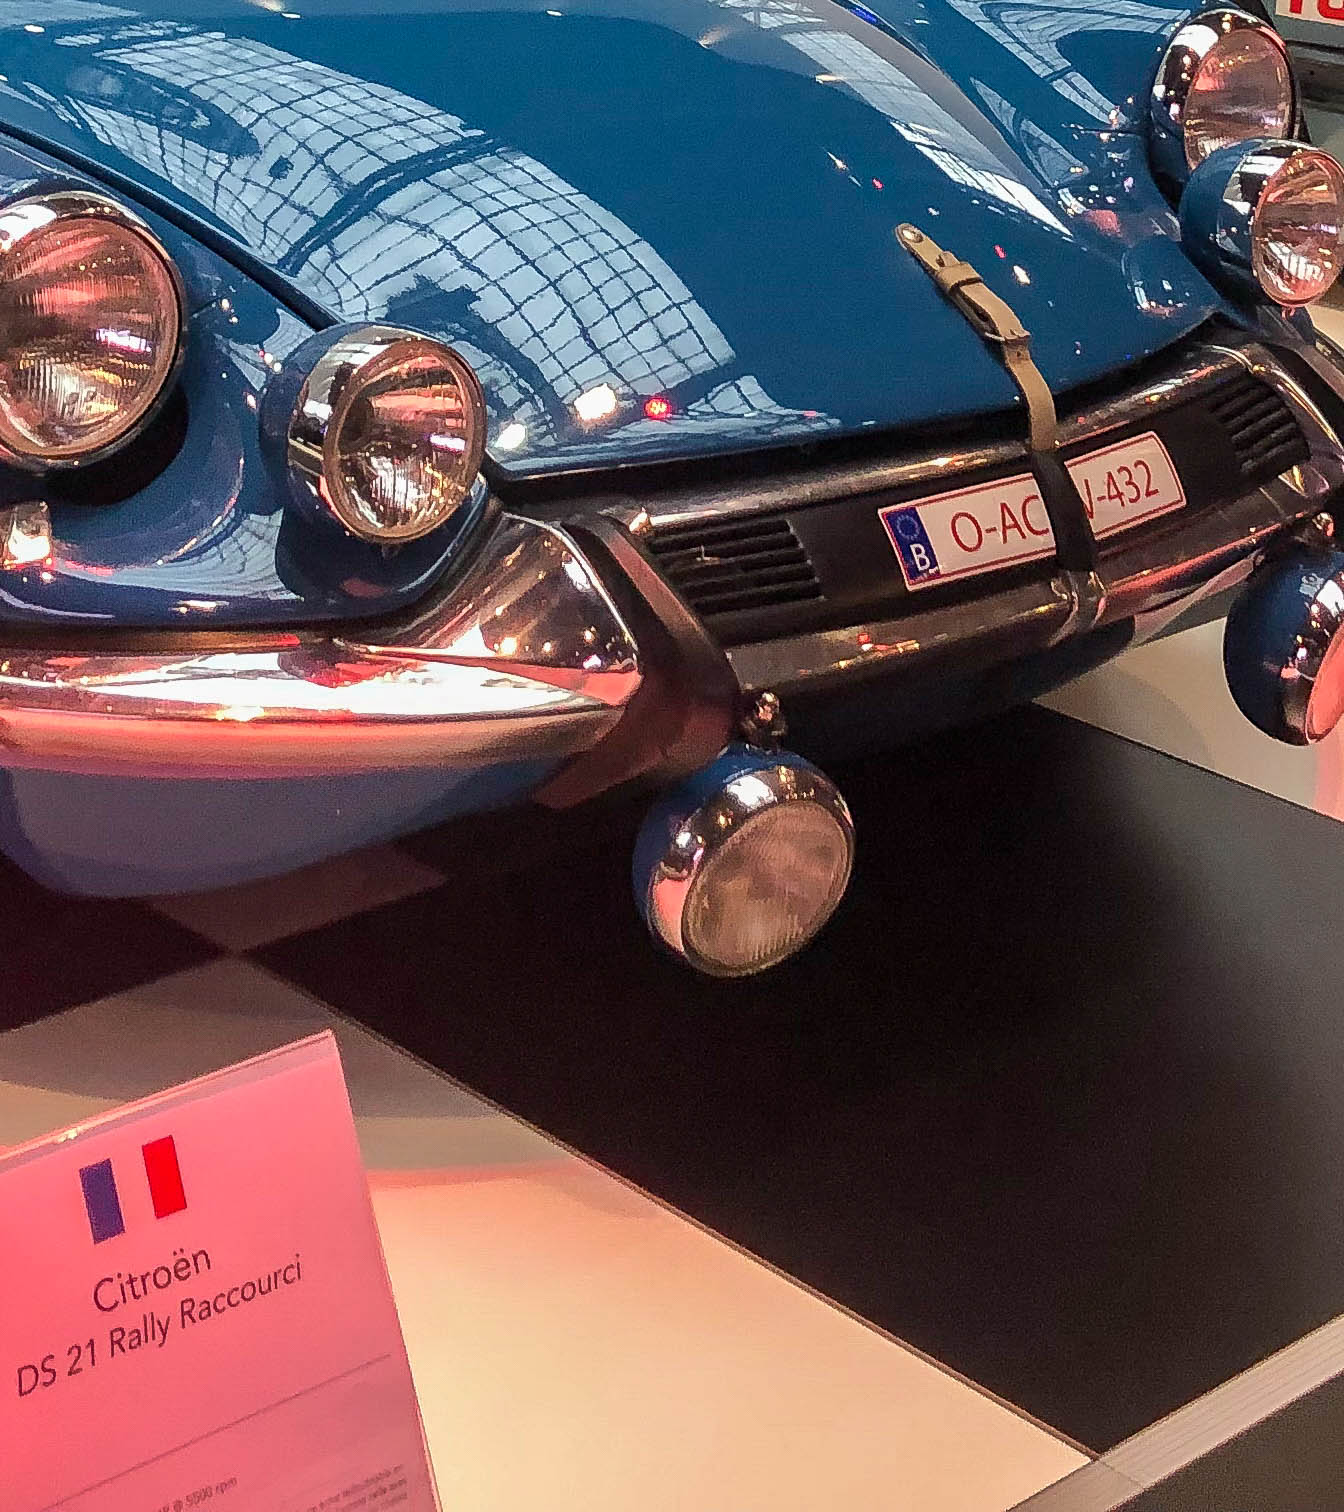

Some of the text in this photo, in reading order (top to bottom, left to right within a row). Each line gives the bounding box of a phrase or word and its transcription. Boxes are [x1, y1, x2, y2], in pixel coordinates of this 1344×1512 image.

[908, 542, 932, 572] B
[92, 1247, 212, 1313] Citroën
[16, 1252, 302, 1398] DS 21 Rally Raccourci
